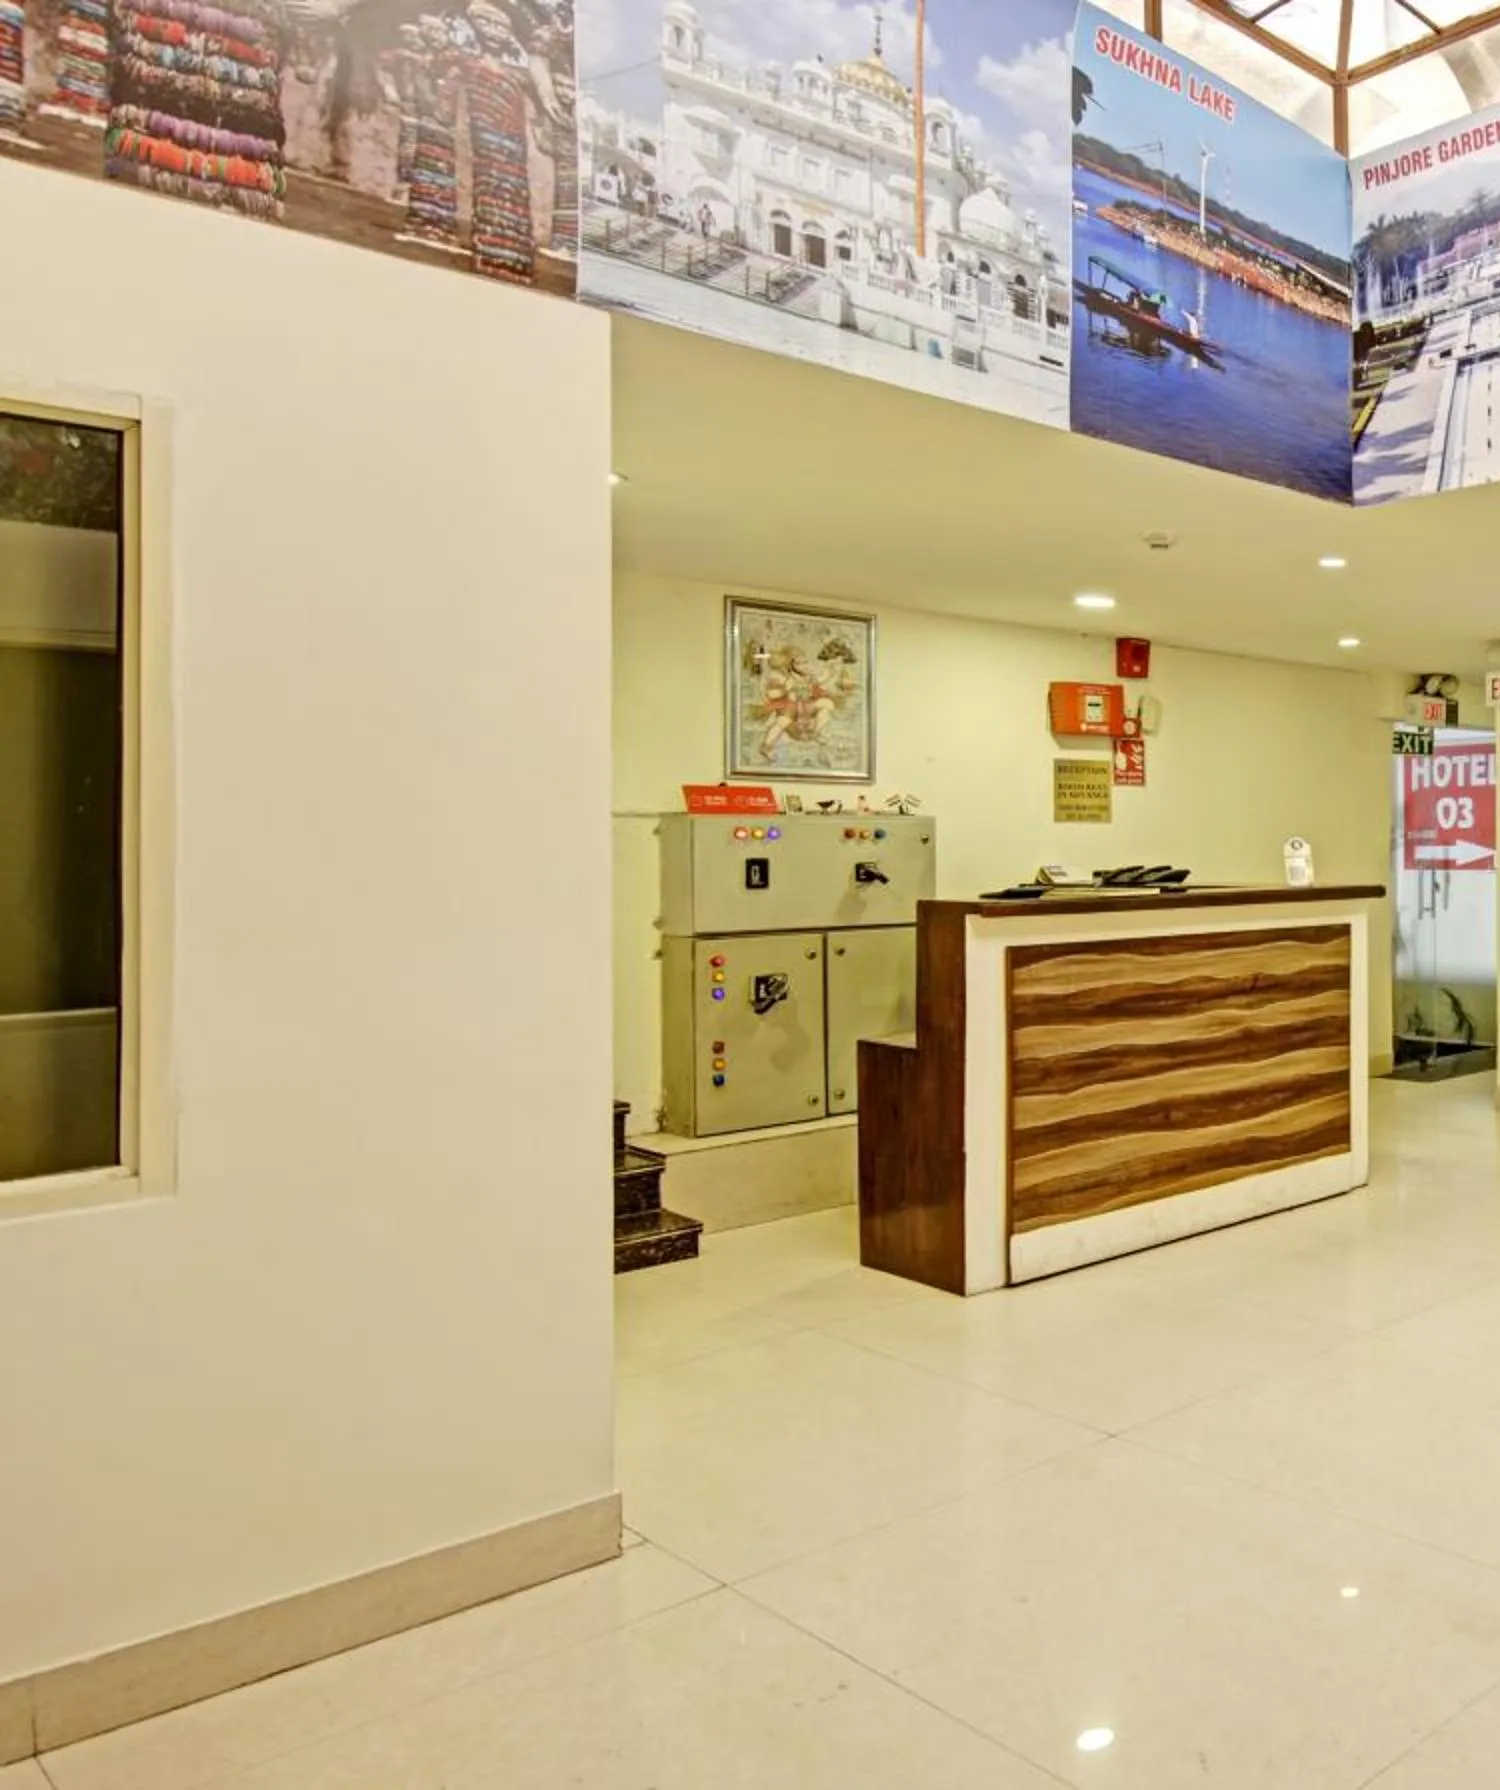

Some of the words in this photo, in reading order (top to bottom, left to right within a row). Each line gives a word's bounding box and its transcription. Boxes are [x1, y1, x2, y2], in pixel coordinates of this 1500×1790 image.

[1096, 27, 1182, 93] SUKHNA
[1188, 76, 1234, 122] LAKE
[1363, 145, 1433, 190] PINJORE
[1424, 703, 1444, 721] EXIT
